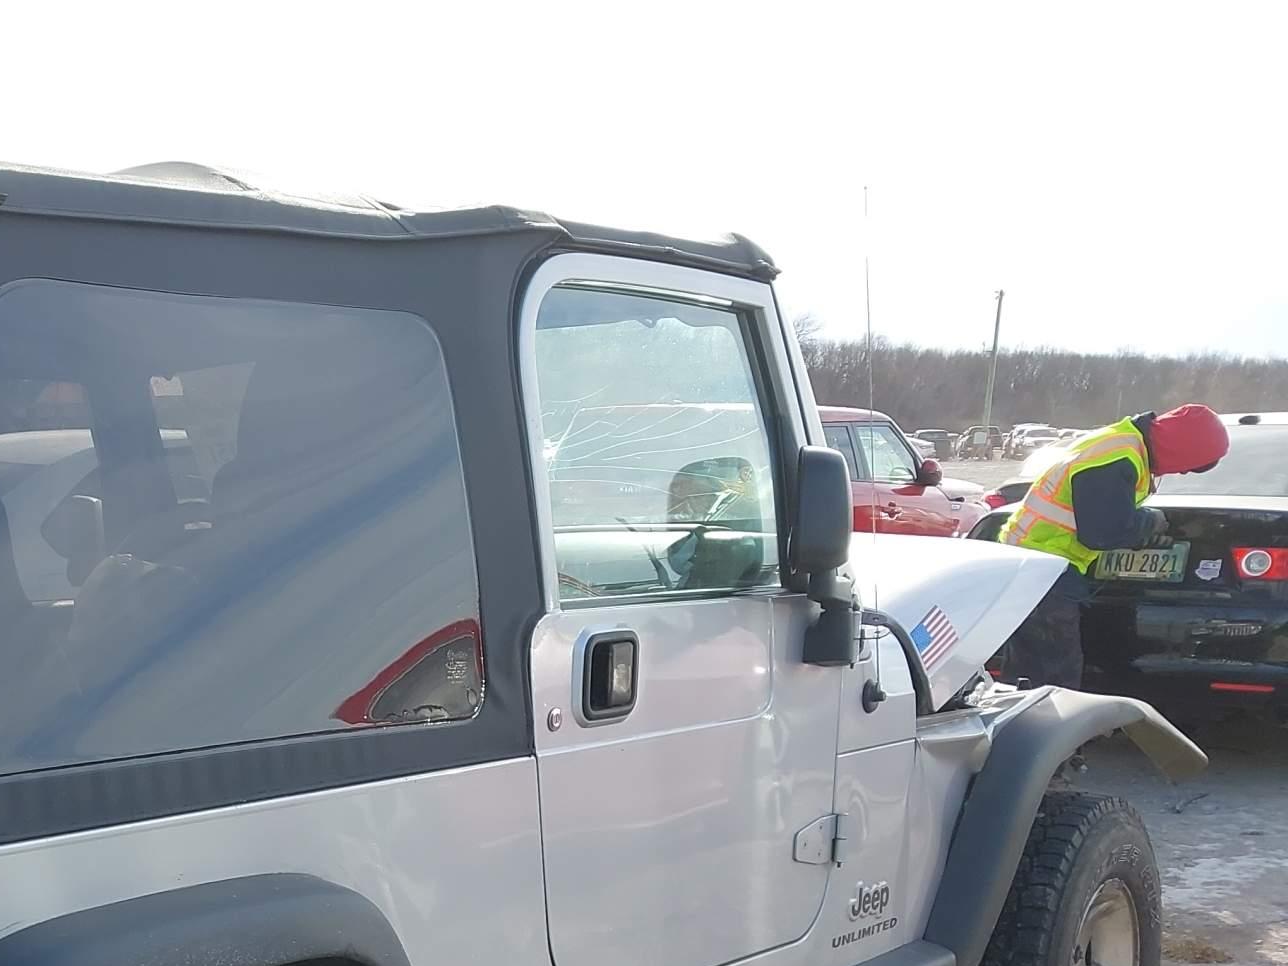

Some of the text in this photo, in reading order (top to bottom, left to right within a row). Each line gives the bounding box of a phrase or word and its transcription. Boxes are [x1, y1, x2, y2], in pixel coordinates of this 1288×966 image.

[1139, 553, 1177, 573] 2821
[850, 883, 890, 918] Jeep
[832, 918, 898, 948] UNLIMITED
